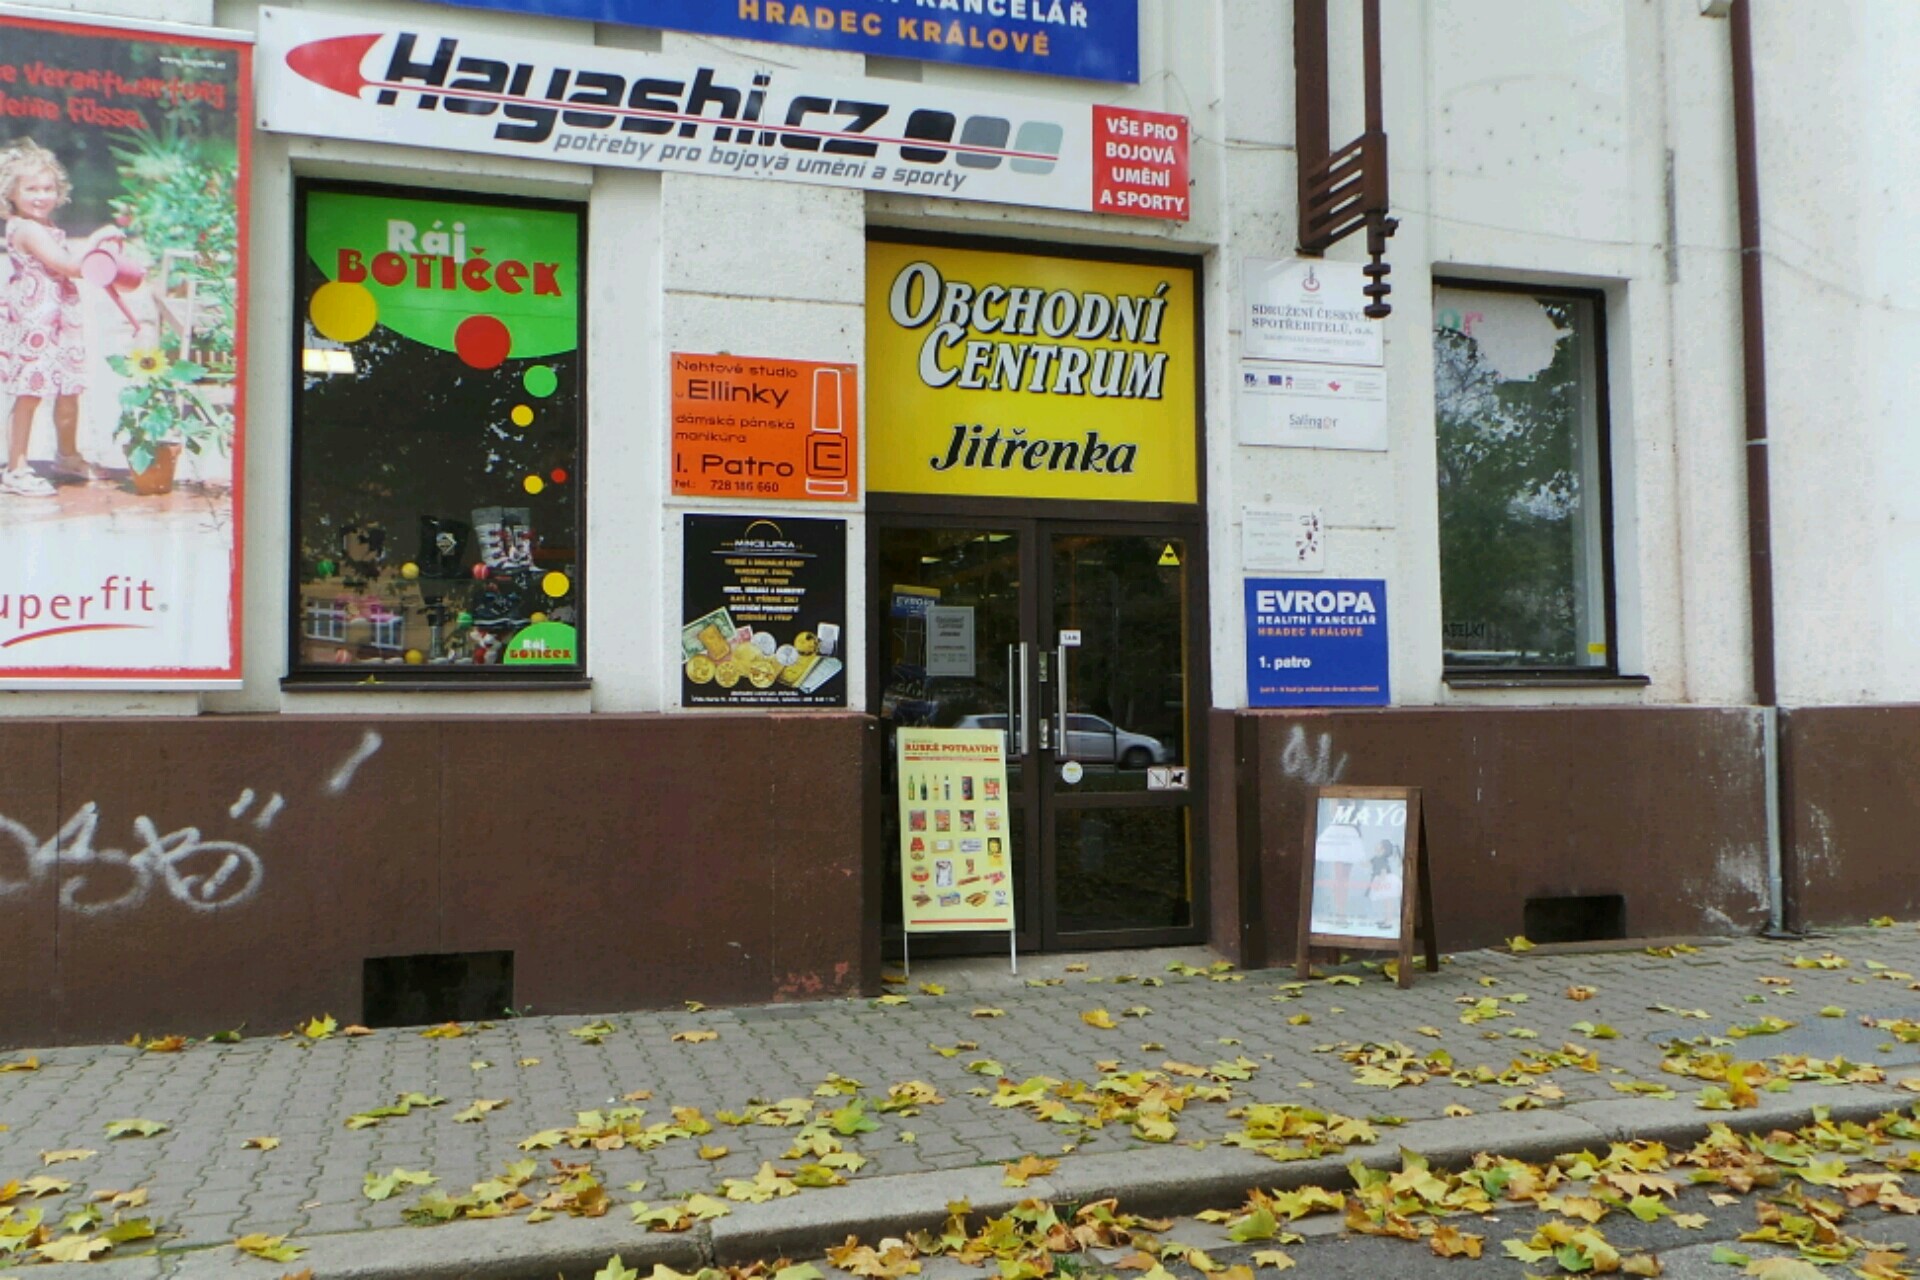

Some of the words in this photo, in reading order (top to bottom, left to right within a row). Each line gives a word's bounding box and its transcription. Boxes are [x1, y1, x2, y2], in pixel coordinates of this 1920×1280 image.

[738, 0, 882, 36] HRADEC
[898, 18, 1050, 56] KRÁLOVÉ
[376, 33, 890, 157] Hayashi.cz
[1106, 116, 1139, 137] VŠE
[1142, 122, 1179, 141] PRO
[553, 133, 655, 163] potřeby
[658, 143, 701, 163] pro
[708, 145, 790, 174] bojová
[796, 156, 866, 179] umění
[871, 167, 887, 181] a
[893, 167, 968, 192] sporty
[1105, 141, 1176, 165] BOJOVÁ
[1111, 166, 1170, 188] UMĚNÍ
[1100, 189, 1113, 206] A
[1117, 191, 1185, 212] SPORTY
[387, 218, 466, 264] Ráj
[676, 360, 743, 373] Nehtové
[749, 365, 798, 379] studio
[918, 321, 1170, 400] CENTRUM
[688, 378, 790, 409] Ellinky
[675, 413, 736, 427] dámská
[740, 417, 796, 431] pánská
[930, 423, 1138, 474] Jitřenka
[701, 453, 795, 477] Patro
[710, 479, 732, 491] 728
[1256, 590, 1377, 613] EVROPA
[1257, 614, 1312, 625] REALITNÍ
[1315, 613, 1377, 625] KANCELÁŘ
[1257, 627, 1306, 637] HRADEC
[1310, 626, 1364, 638] KRÁLOVÉ
[1258, 656, 1271, 669] 1.
[1274, 655, 1312, 671] patro
